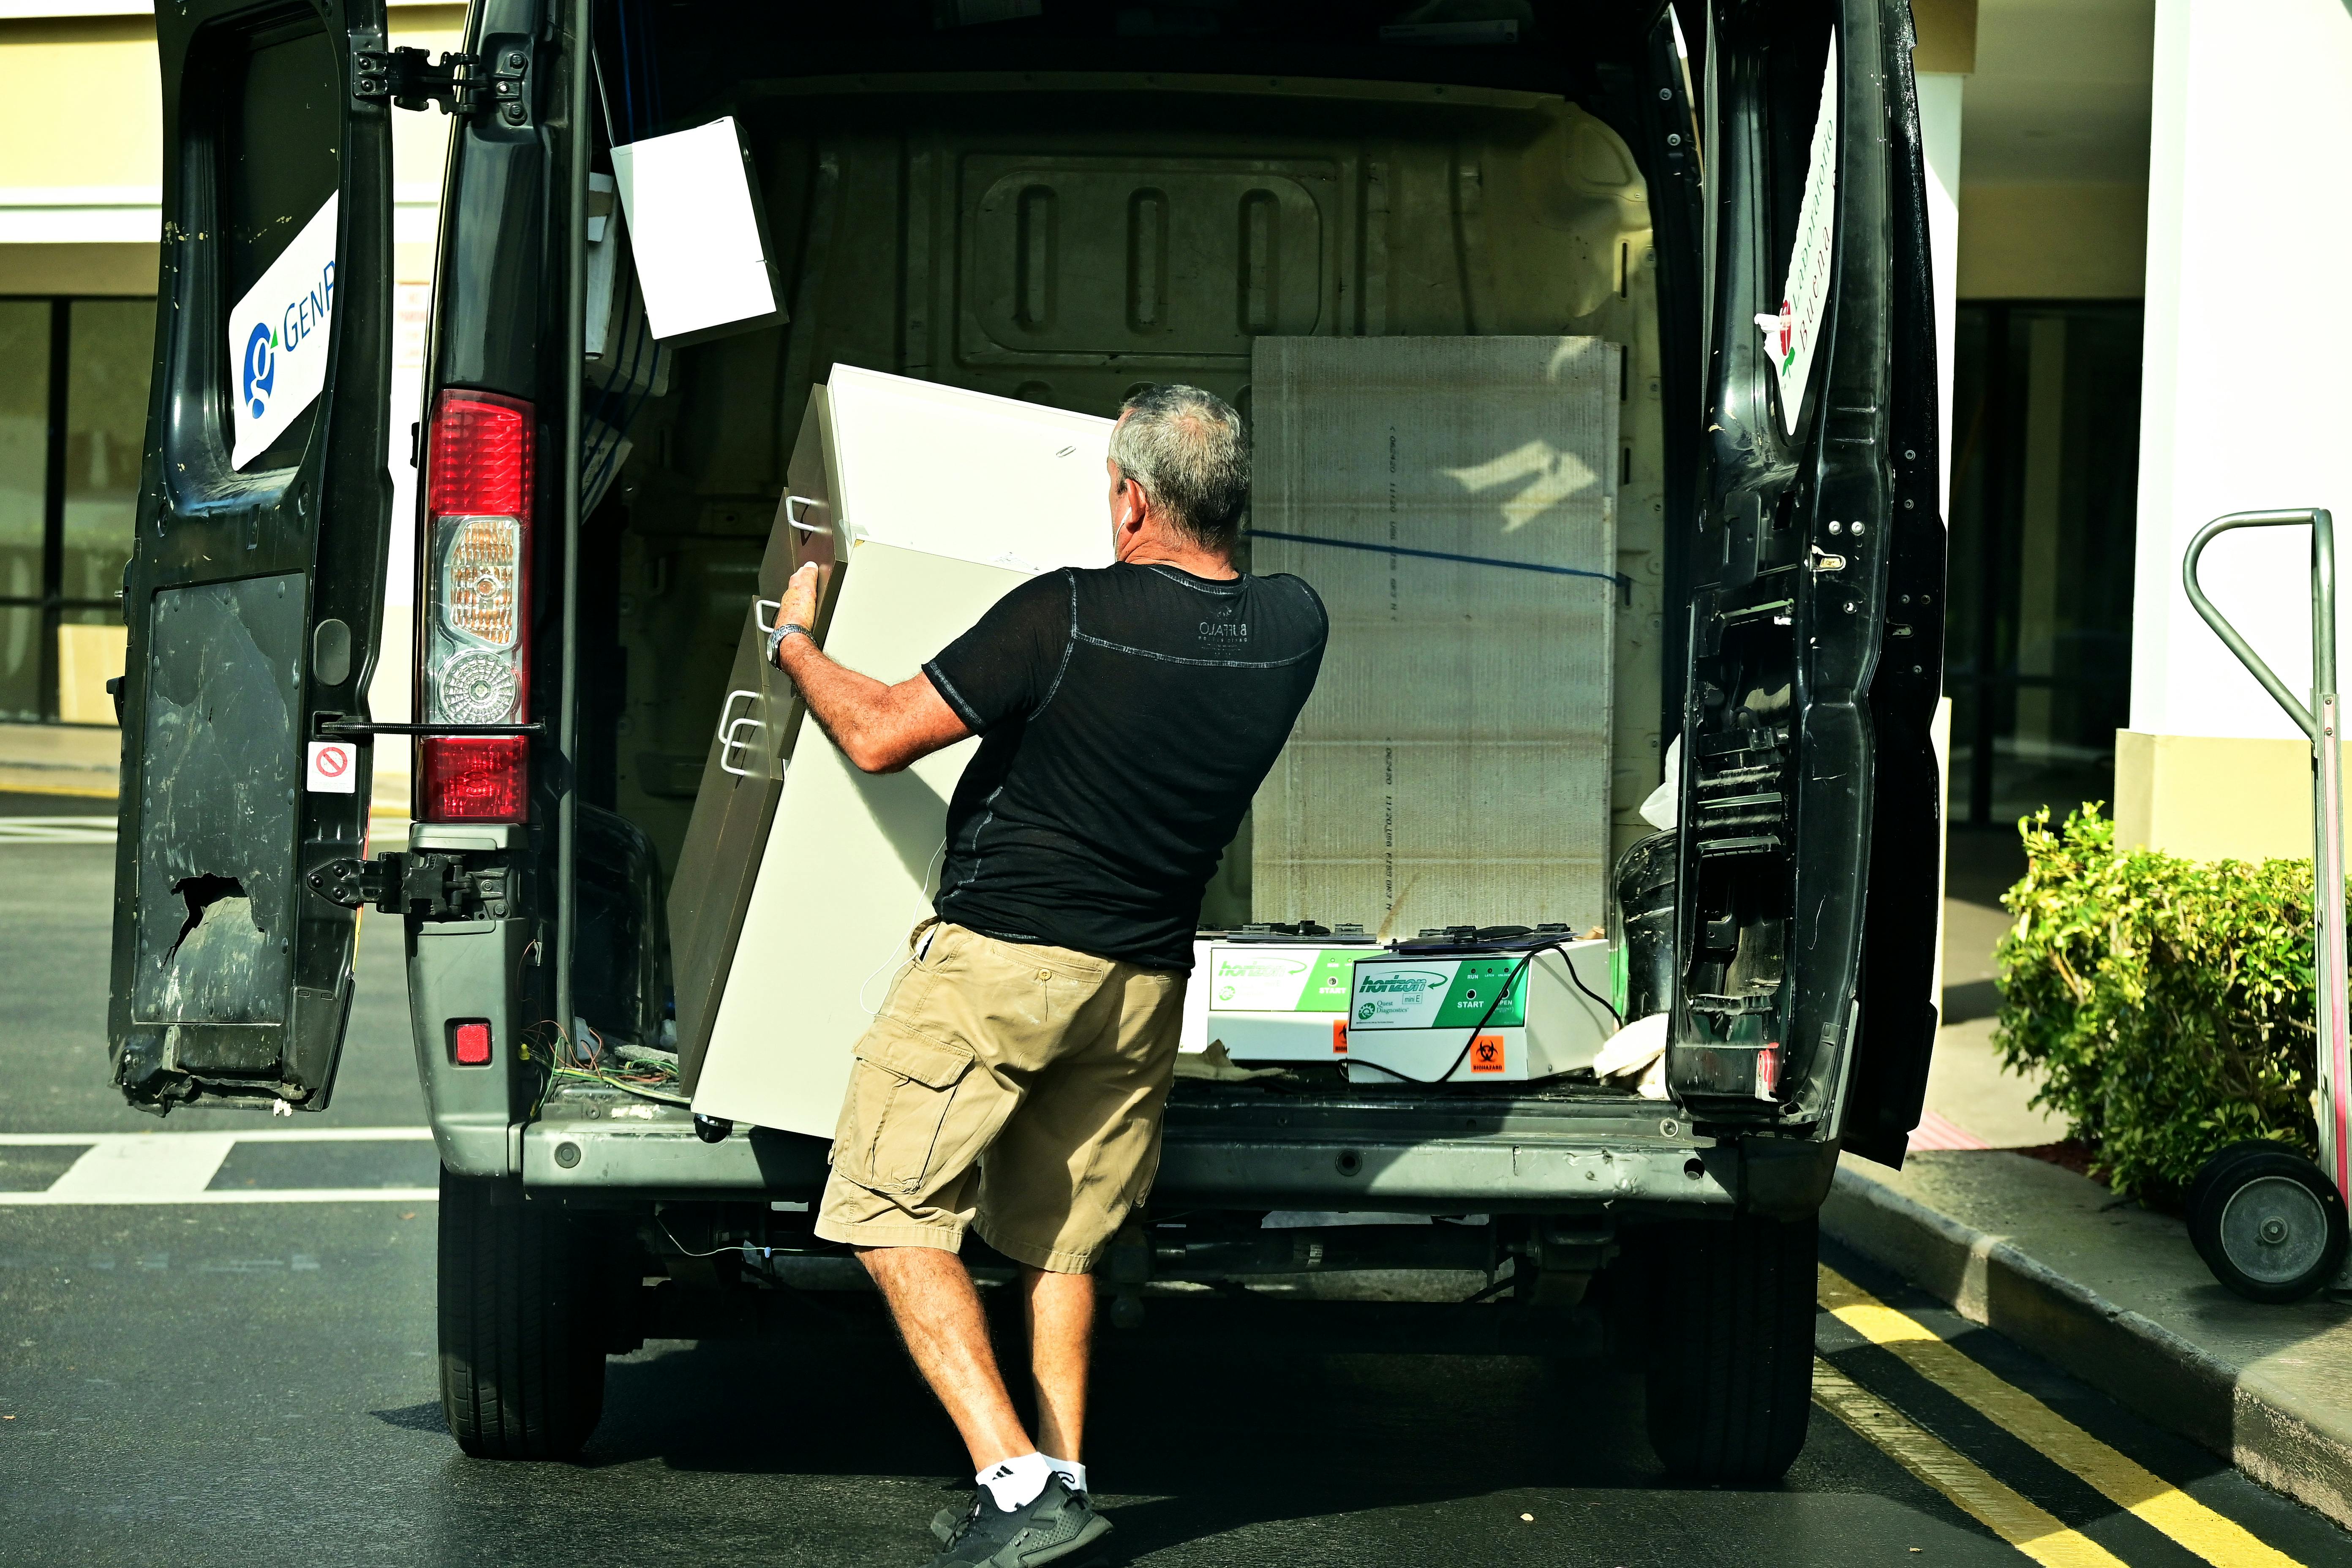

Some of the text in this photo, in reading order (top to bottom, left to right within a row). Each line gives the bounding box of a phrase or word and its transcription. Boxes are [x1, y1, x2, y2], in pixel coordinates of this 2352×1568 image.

[1799, 226, 1829, 353] Buena
[1218, 961, 1286, 977] horizon
[1359, 975, 1426, 993] horizon
